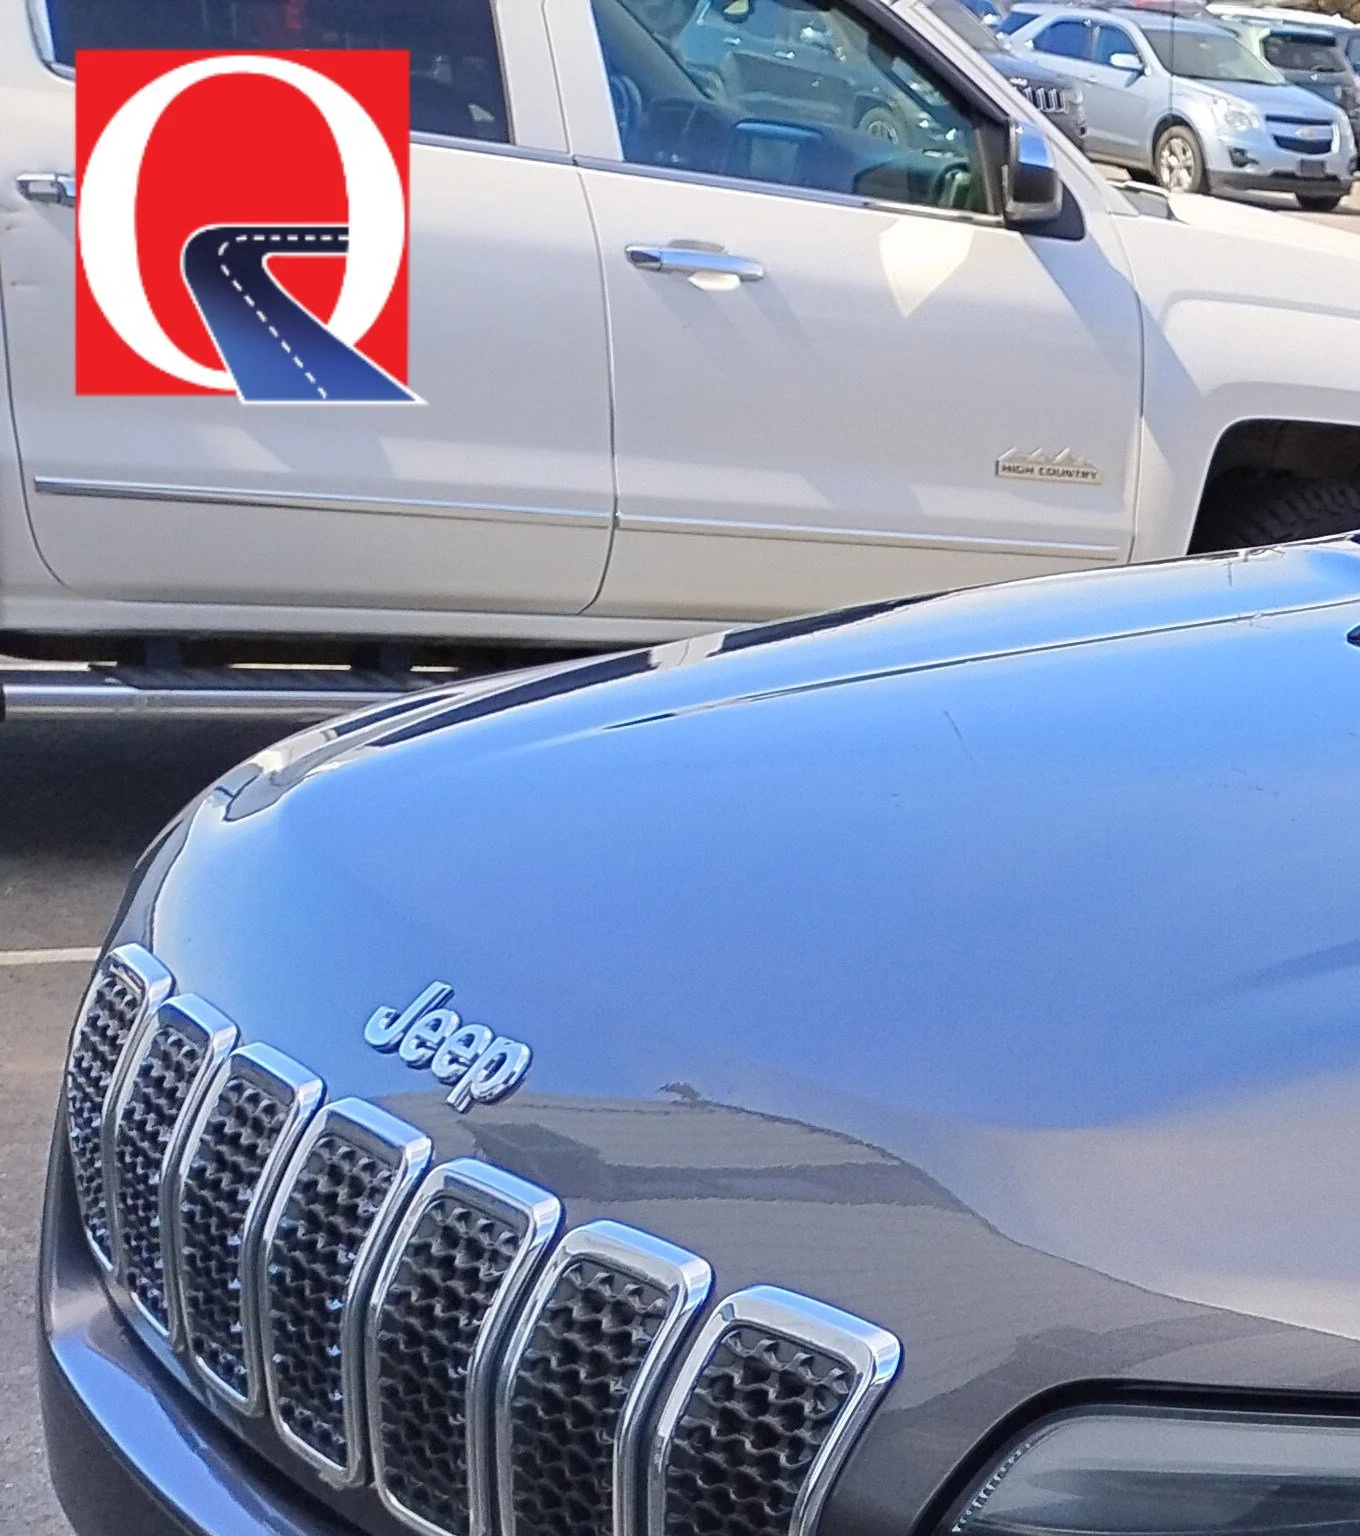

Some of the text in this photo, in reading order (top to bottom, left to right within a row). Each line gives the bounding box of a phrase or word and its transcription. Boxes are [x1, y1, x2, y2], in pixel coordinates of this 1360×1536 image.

[1001, 464, 1099, 479] HIGH COUNTRY
[363, 980, 533, 1113] Jeep
